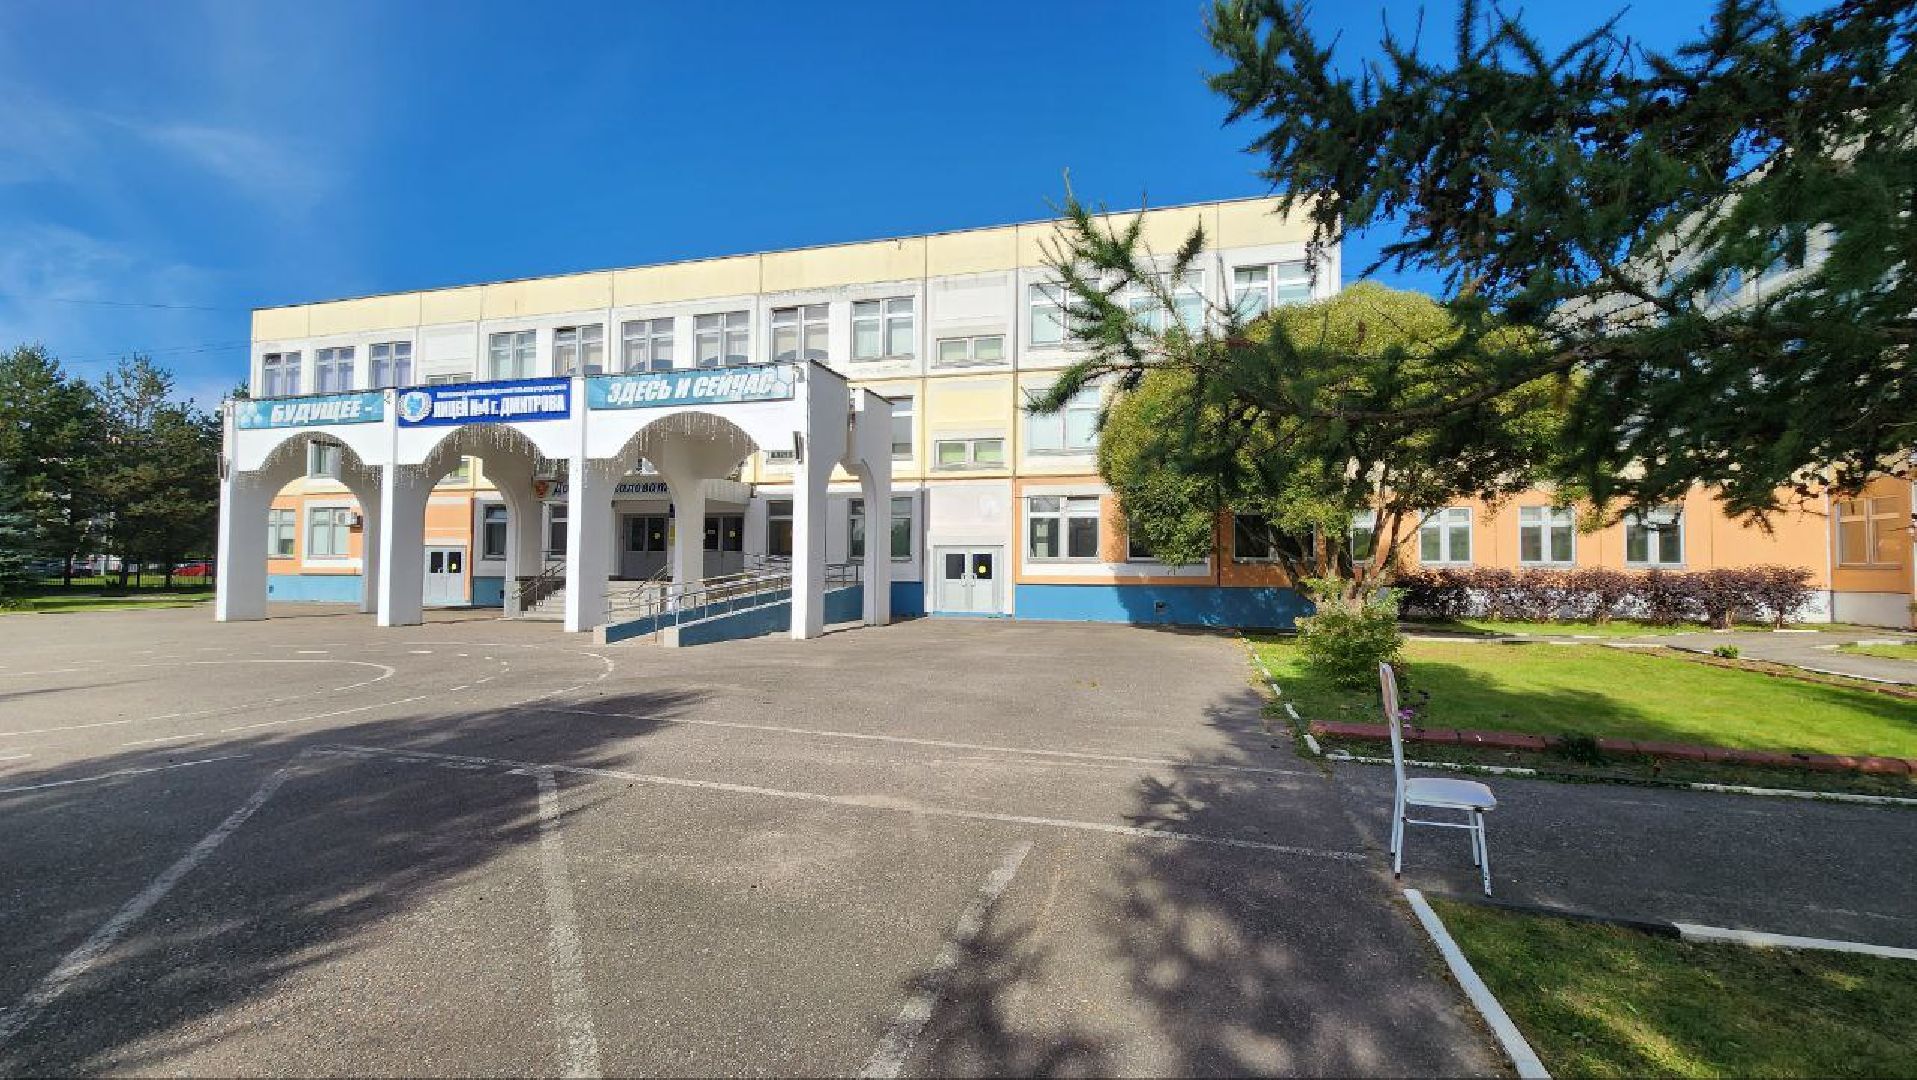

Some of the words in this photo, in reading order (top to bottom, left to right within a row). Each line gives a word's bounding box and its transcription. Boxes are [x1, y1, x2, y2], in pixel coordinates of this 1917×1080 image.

[607, 380, 672, 405] ЗДЕСЬ
[675, 379, 691, 399] И
[693, 374, 775, 398] СЕЙЧАС
[272, 401, 362, 423] БУДУЩЕЕ
